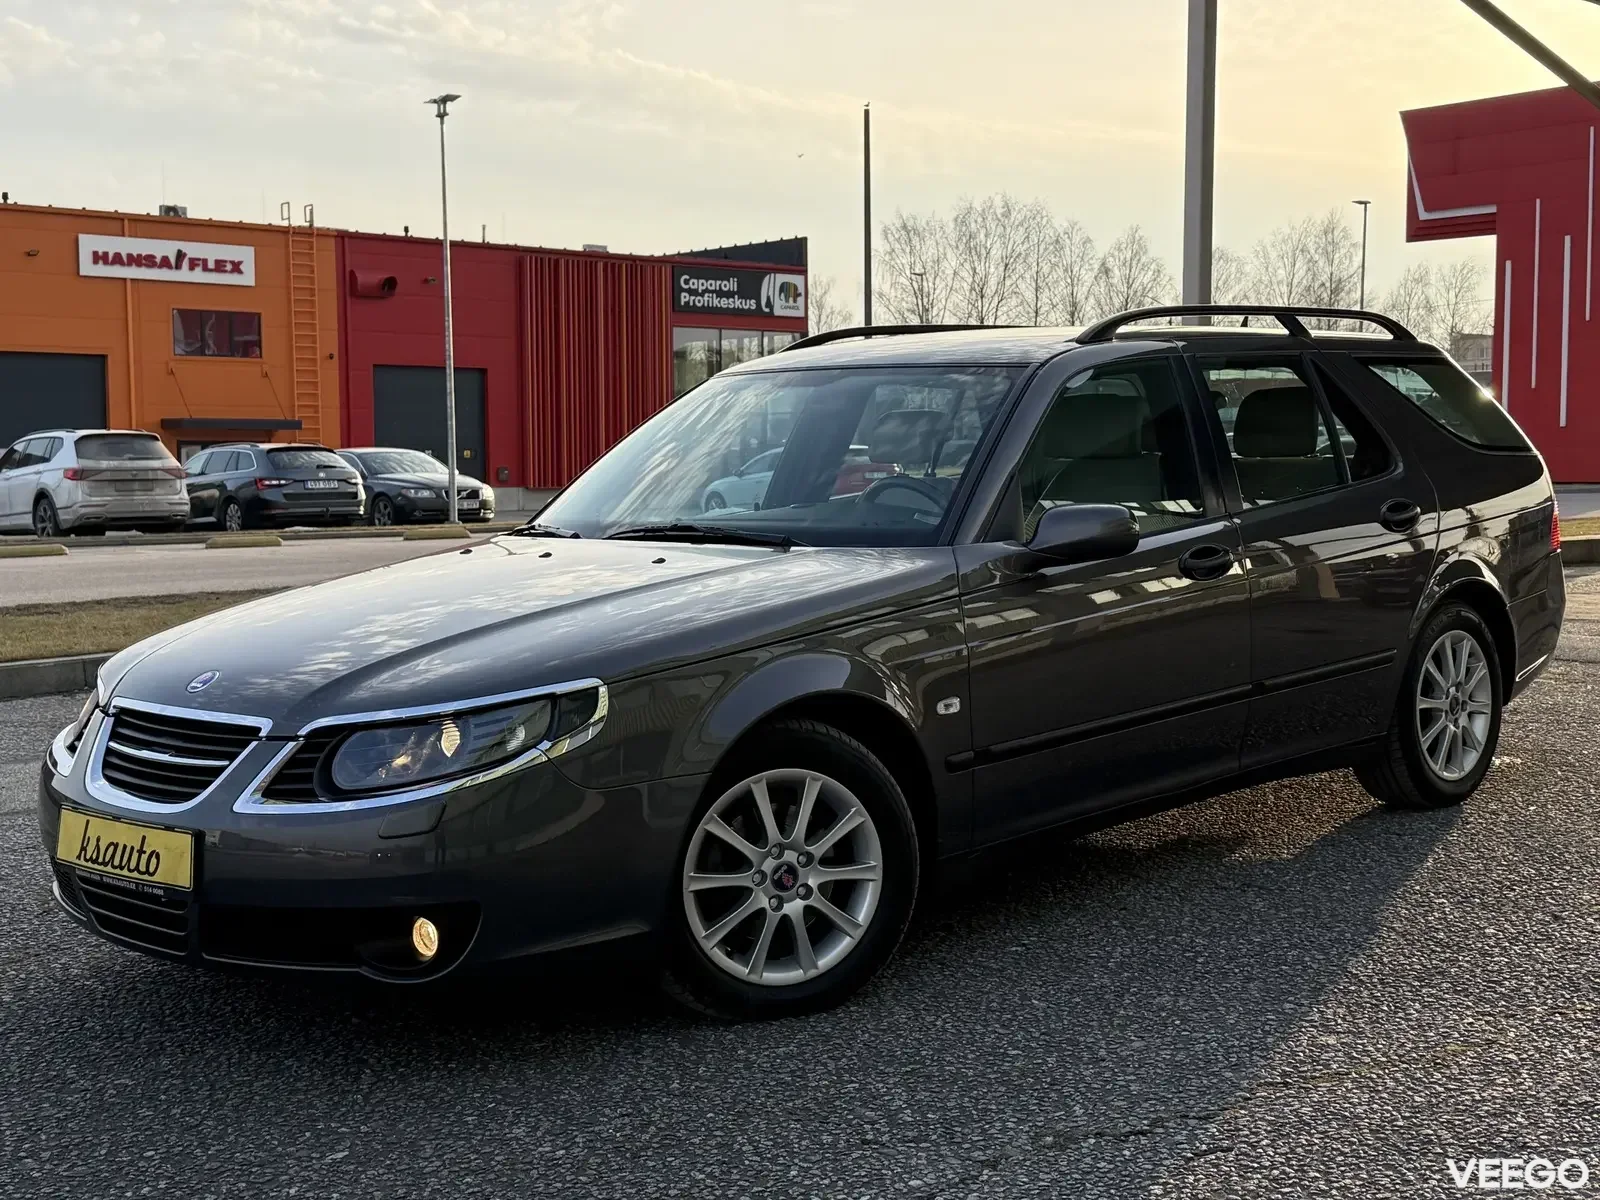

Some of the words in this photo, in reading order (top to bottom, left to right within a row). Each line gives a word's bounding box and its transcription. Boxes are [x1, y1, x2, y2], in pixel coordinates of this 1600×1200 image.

[680, 275, 738, 293] Caparoli
[680, 292, 757, 310] Profikeskus
[75, 819, 161, 877] ksauto
